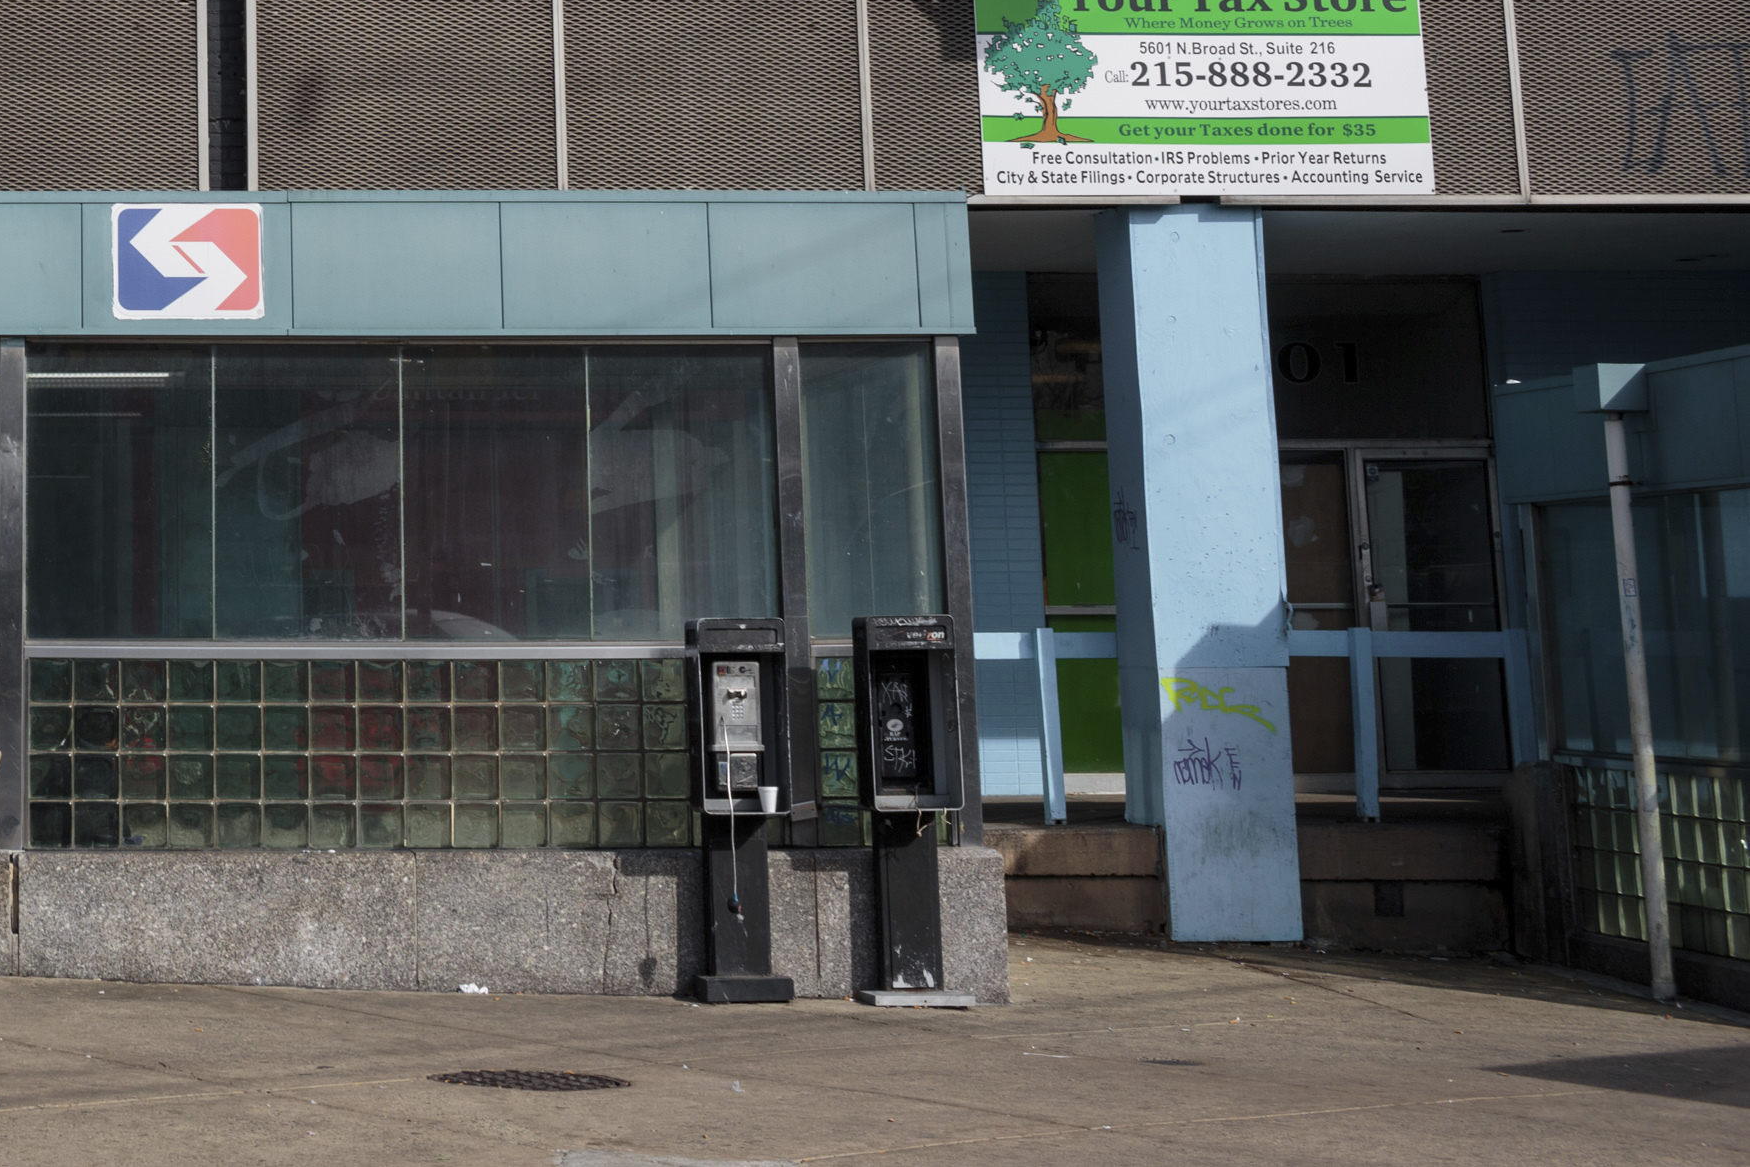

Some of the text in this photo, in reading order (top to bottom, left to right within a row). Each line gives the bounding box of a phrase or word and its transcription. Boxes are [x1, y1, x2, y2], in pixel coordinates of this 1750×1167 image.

[1124, 16, 1353, 31] Where Money Grows on Trees
[1139, 41, 1336, 57] 5601 N.Broad St., Suite 216
[1104, 61, 1373, 88] Call: 215-888-2332
[1145, 96, 1338, 114] www.yourtaxstores.com
[1118, 122, 1377, 140] Get your Taxes done for $35
[1032, 151, 1387, 165] Free Consultation IRS Problems Prior Year Returns
[996, 169, 1423, 187] City & State Filings Corporate Structures Accounting Service
